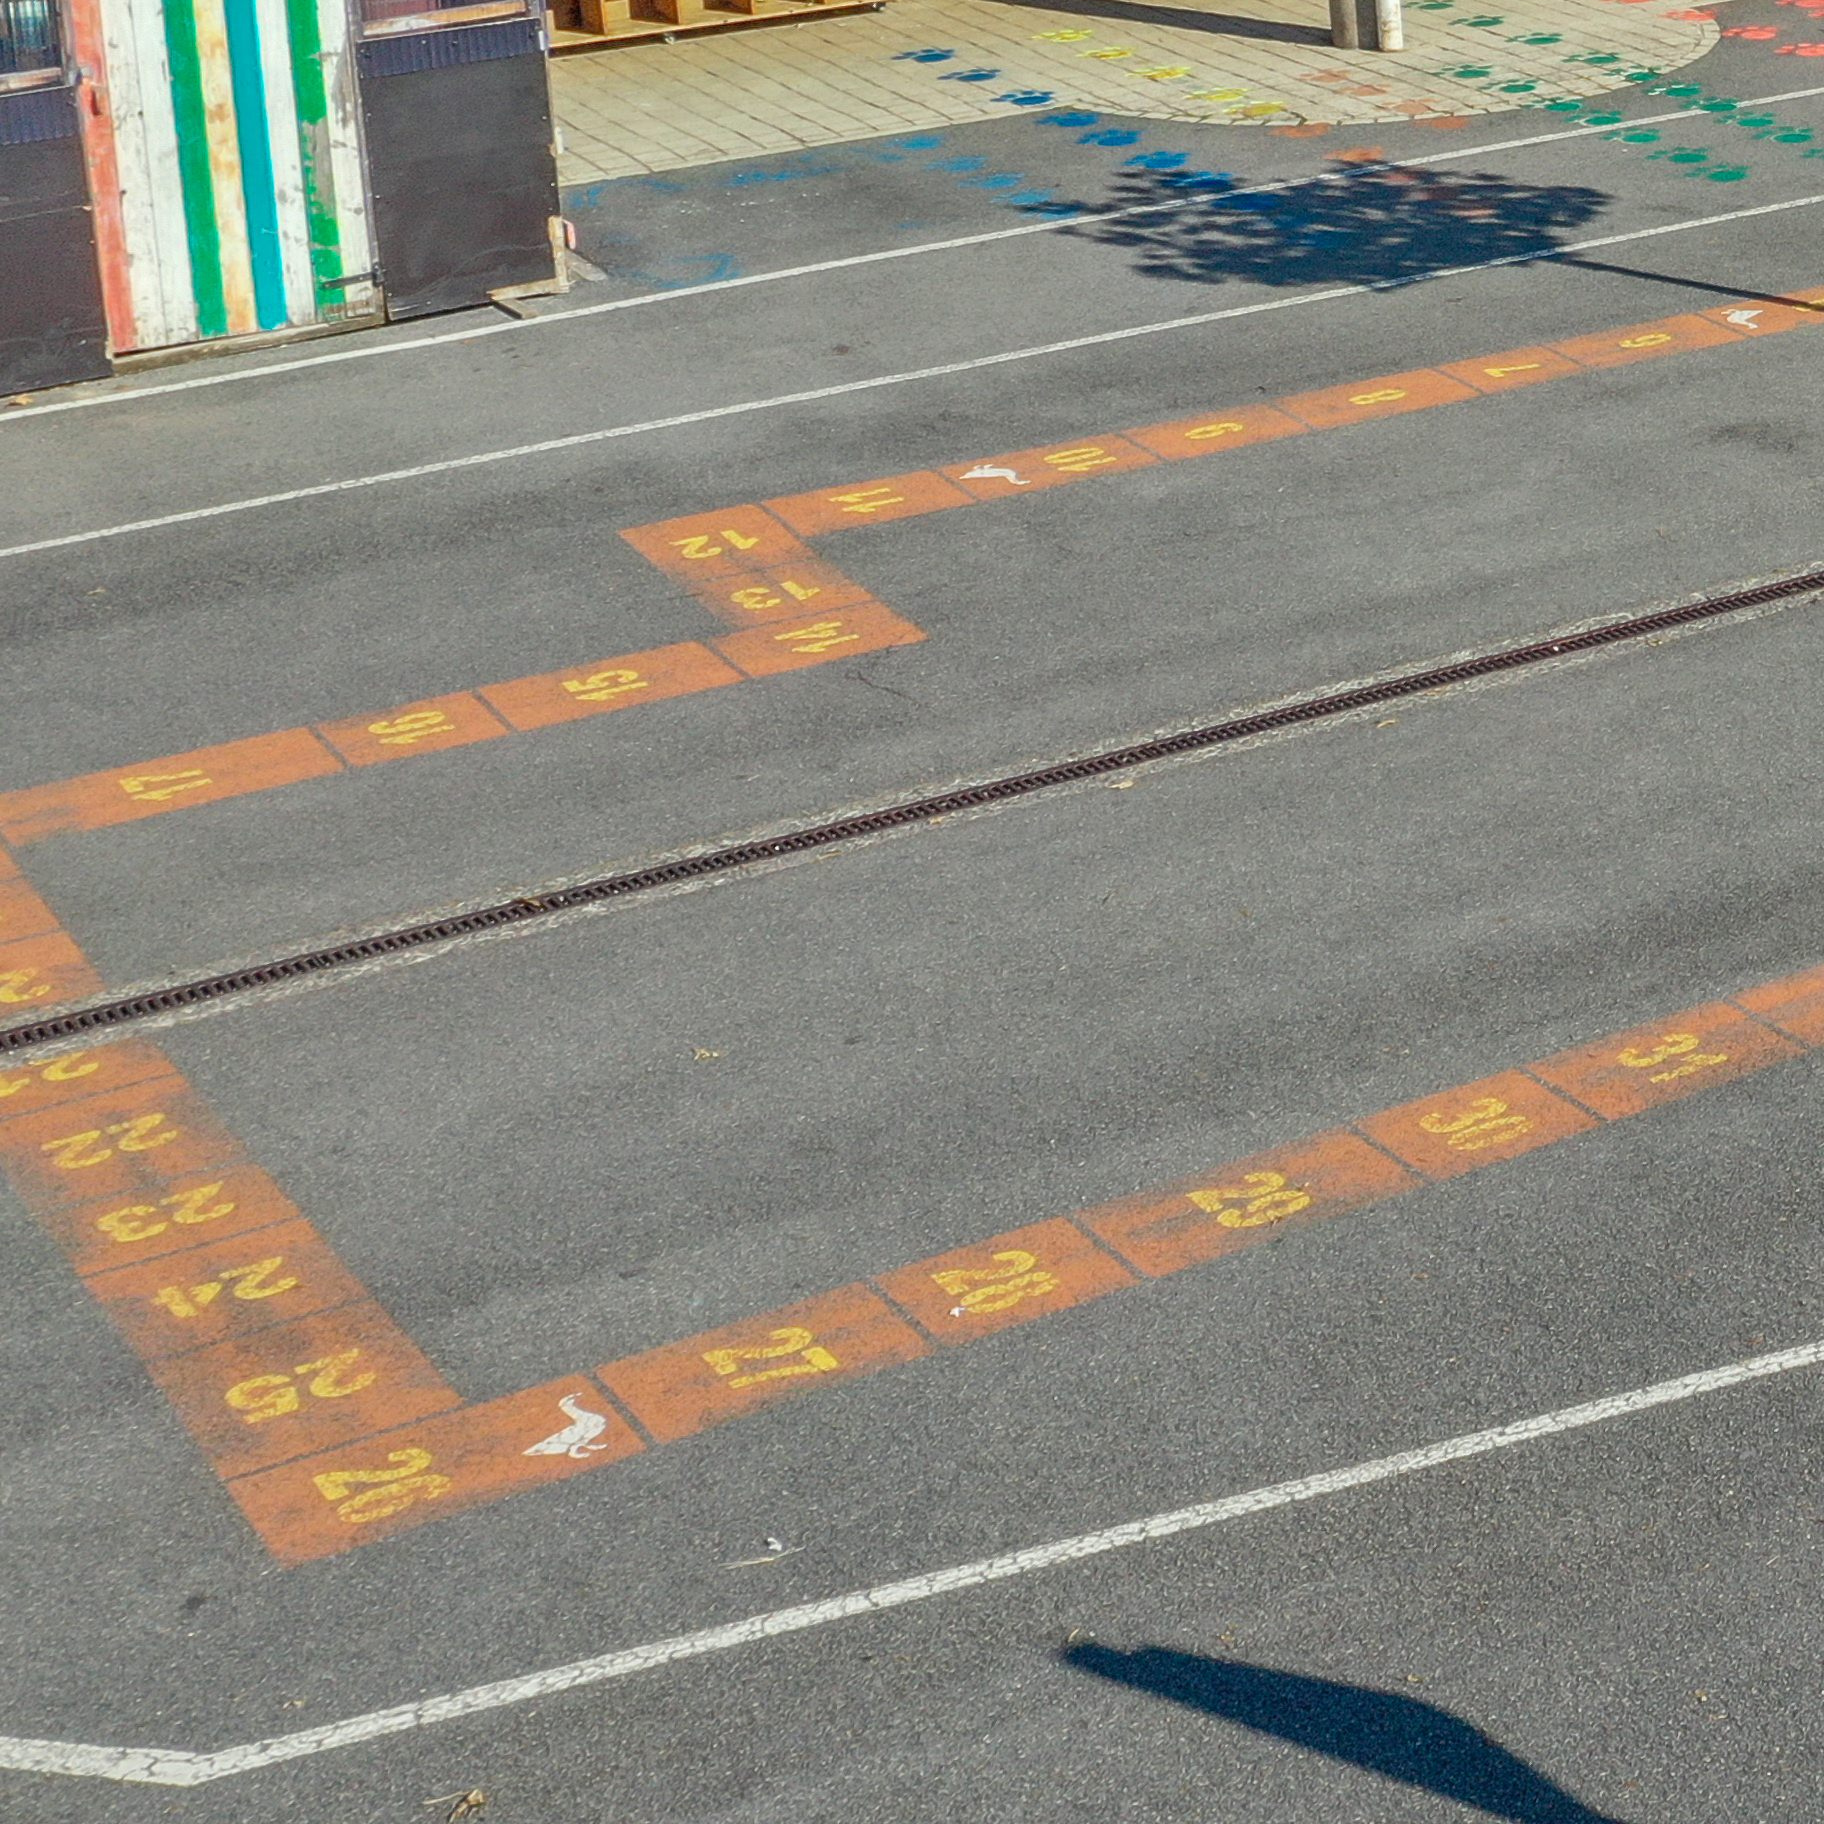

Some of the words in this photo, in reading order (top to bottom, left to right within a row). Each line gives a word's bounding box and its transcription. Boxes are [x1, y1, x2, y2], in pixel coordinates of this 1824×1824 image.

[1617, 332, 1672, 349] 6
[1483, 363, 1540, 378] 7
[1347, 388, 1407, 406] 8
[1184, 422, 1244, 440] 9
[1042, 447, 1118, 472] 10
[828, 488, 905, 513] 11
[668, 529, 759, 560] 12
[730, 580, 821, 610] 13
[773, 620, 860, 653] 14
[562, 668, 650, 703] 15
[366, 709, 457, 746] 16
[119, 768, 213, 803] 17
[1616, 1033, 1729, 1084] 31
[40, 1113, 178, 1170] 22
[1420, 1097, 1534, 1151] 30
[96, 1180, 236, 1243] 23
[1185, 1171, 1313, 1228] 29
[149, 1255, 298, 1319] 24
[930, 1250, 1062, 1314] 28
[702, 1326, 840, 1389] 27
[223, 1347, 377, 1424] 25
[312, 1446, 452, 1524] 26
